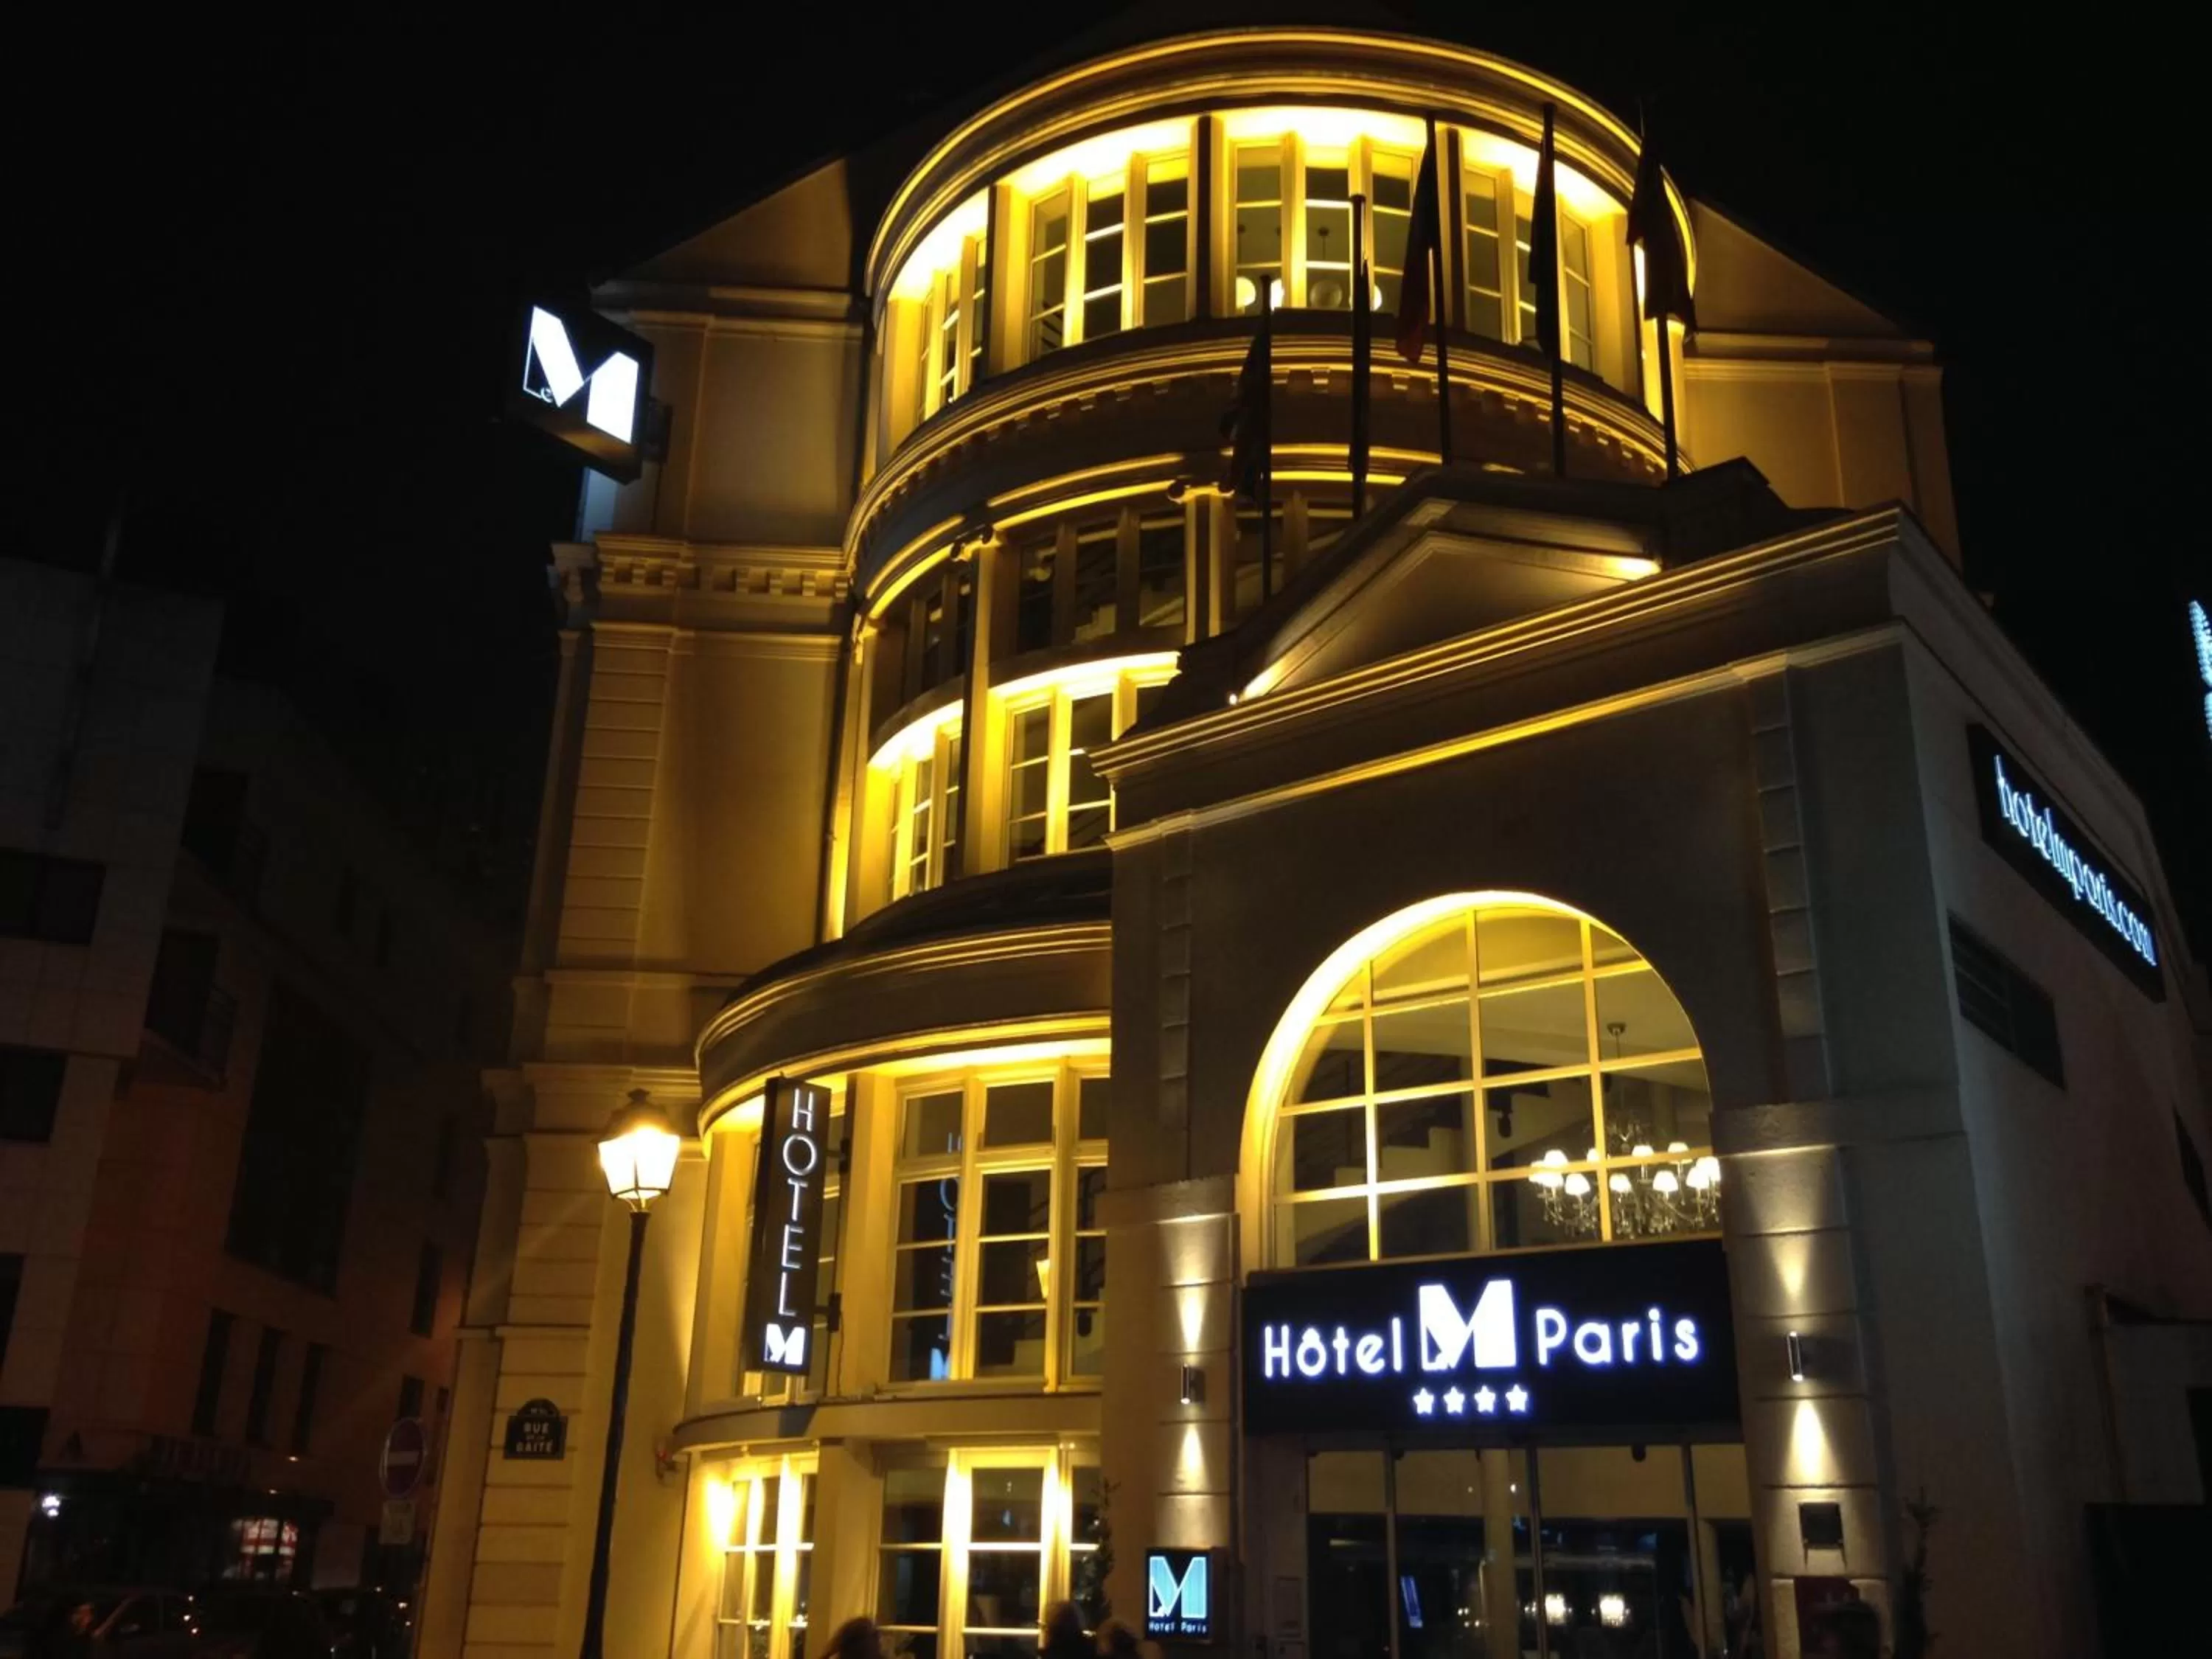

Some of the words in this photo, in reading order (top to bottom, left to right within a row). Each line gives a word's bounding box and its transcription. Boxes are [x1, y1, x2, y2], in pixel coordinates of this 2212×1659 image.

[778, 1088, 818, 1317] HOTEL
[764, 1324, 806, 1365] M
[1265, 1318, 1402, 1378] Hôtel
[1419, 1279, 1517, 1371] M
[1536, 1307, 1700, 1366] Paris
[1149, 1557, 1207, 1618] M
[1180, 1621, 1207, 1633] Paris
